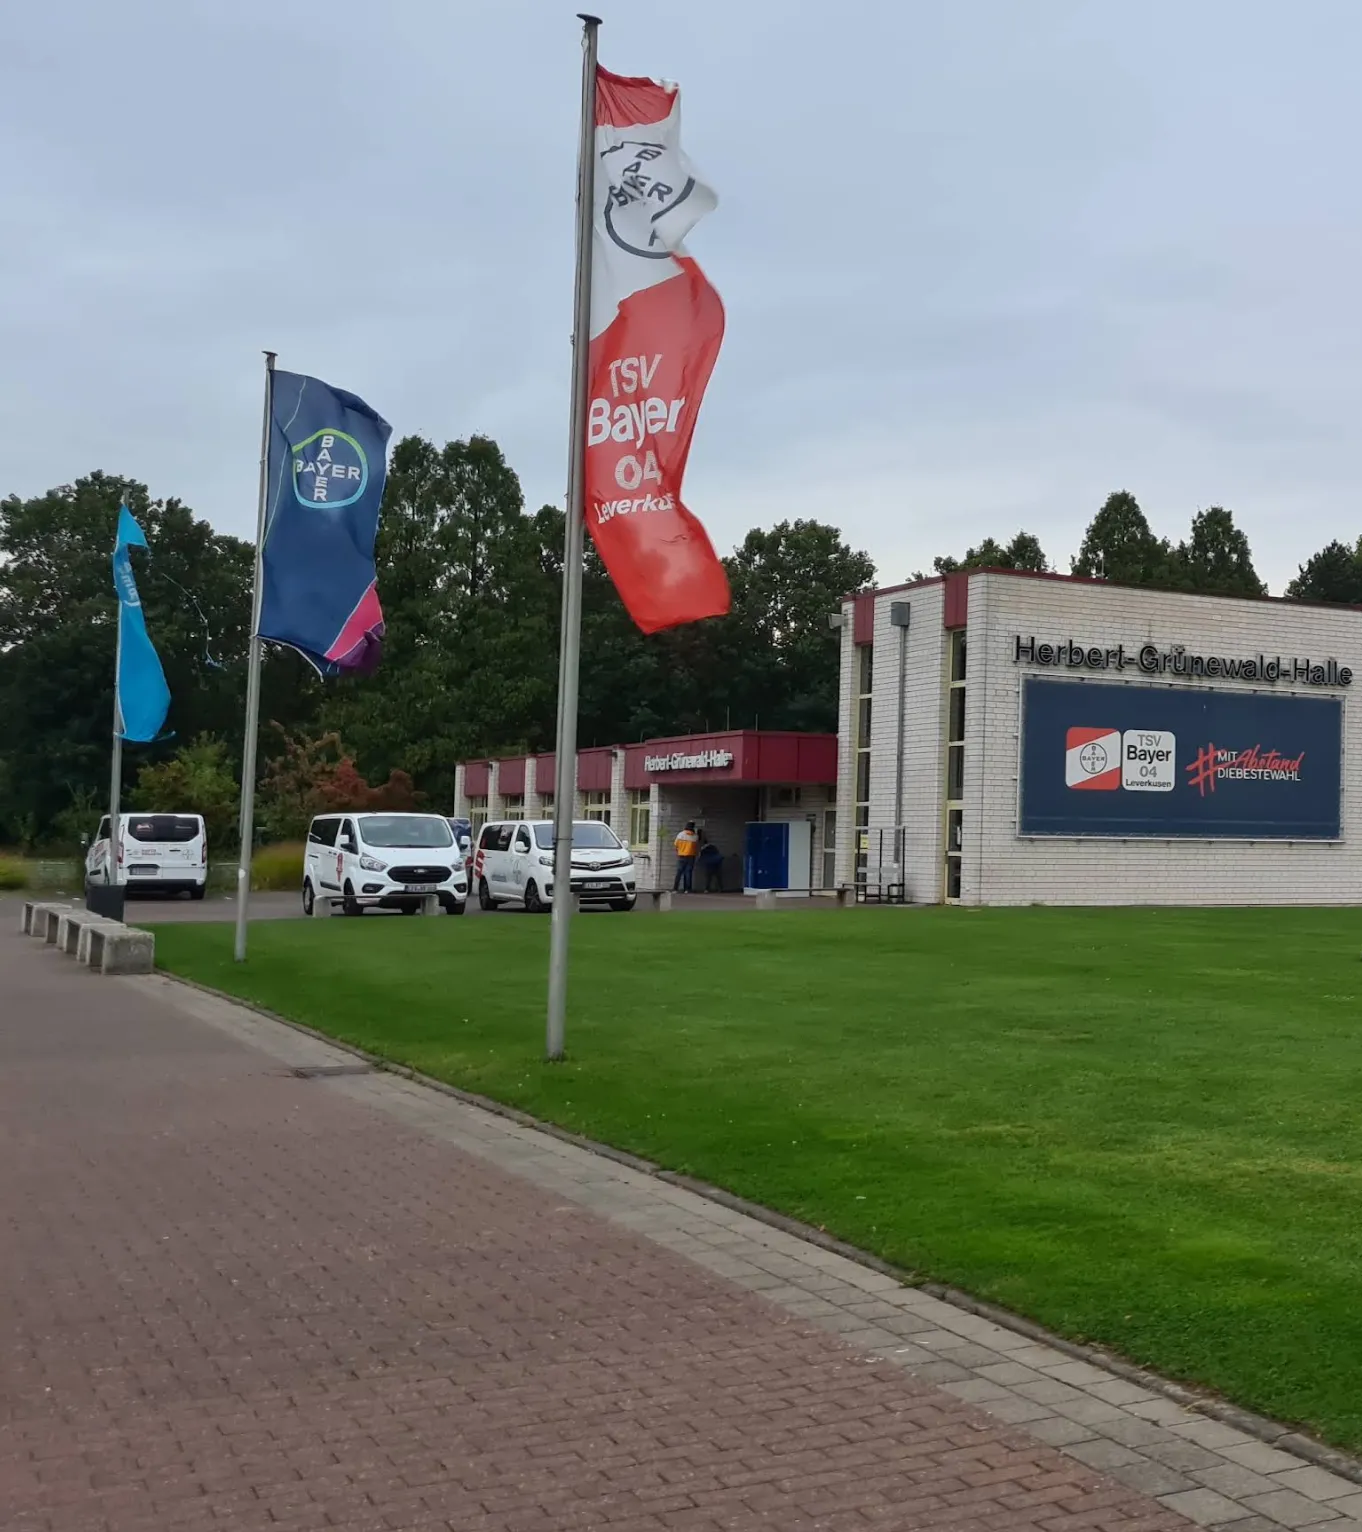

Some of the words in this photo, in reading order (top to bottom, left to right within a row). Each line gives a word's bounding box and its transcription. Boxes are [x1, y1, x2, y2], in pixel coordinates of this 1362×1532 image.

[608, 354, 662, 397] TSV
[588, 397, 685, 449] Bayer
[296, 460, 361, 480] BAYER
[313, 435, 335, 501] BAYER
[614, 450, 662, 490] 04
[1013, 635, 1353, 686] Herbert-Grünewald-Halle
[1137, 734, 1161, 746] TSV
[1127, 744, 1171, 764] Bayer
[1234, 744, 1305, 770] Abstand
[1139, 765, 1157, 778] 04
[1218, 767, 1301, 781] DIEBESTEWAHL
[1125, 779, 1172, 788] Leverkusen
